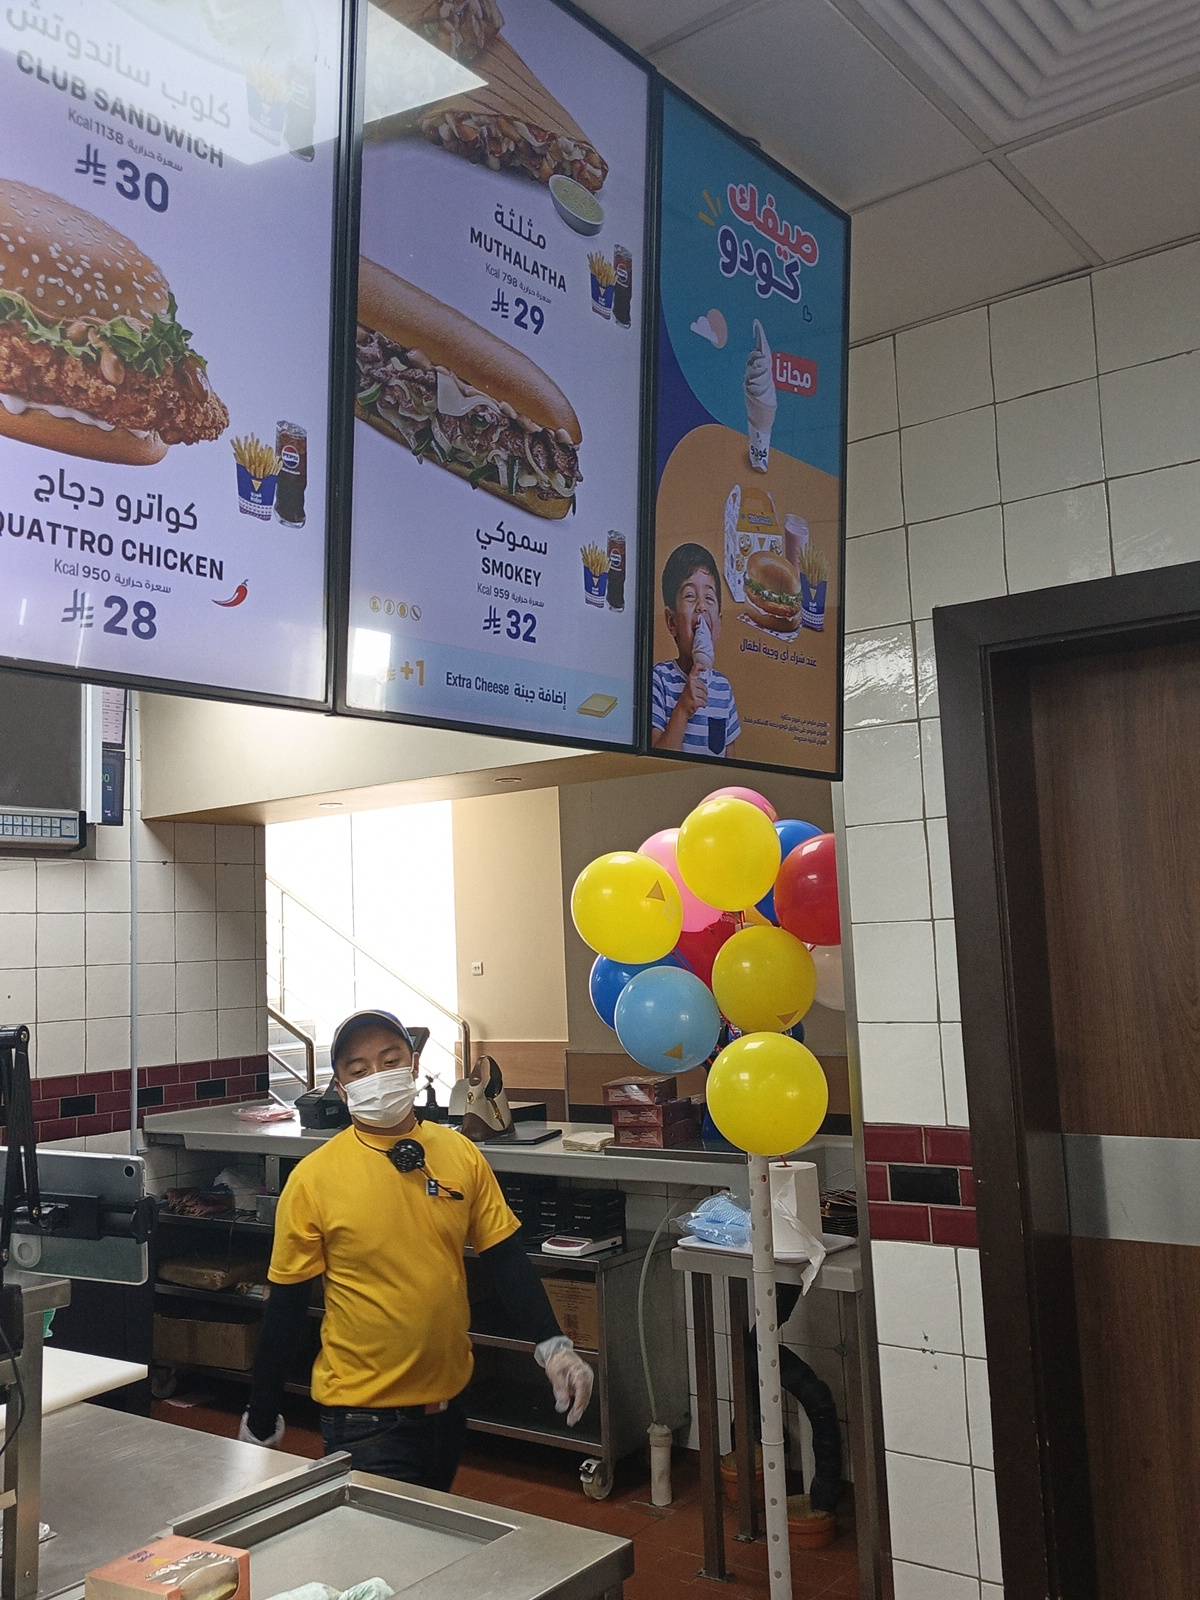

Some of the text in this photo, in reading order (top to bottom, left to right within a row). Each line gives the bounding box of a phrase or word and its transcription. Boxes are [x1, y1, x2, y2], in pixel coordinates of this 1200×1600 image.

[17, 50, 224, 169] CLUB SANDWICH
[68, 107, 93, 131] Kcal
[95, 121, 124, 145] 1138
[116, 159, 169, 213] 30
[494, 203, 546, 250] مثلثة
[727, 183, 819, 267] صيفك
[470, 226, 567, 293] MUTHALATHA
[485, 262, 500, 279] Kcal
[502, 272, 518, 288] 798
[718, 225, 801, 303] كودو
[514, 297, 545, 335] 29
[34, 469, 198, 534] كواترو دجاج
[476, 521, 548, 555] سموكي
[54, 558, 172, 594] Kcal 950 سعرة حرارية
[121, 538, 224, 581] CHICKEN
[481, 556, 542, 587] SMOKEY
[477, 582, 492, 596] Kcal
[493, 587, 510, 600] 959
[103, 594, 157, 640] 28
[506, 609, 537, 643] 32
[400, 659, 426, 688] +1
[446, 671, 567, 710] Extra Cheese إضافة جبنة
